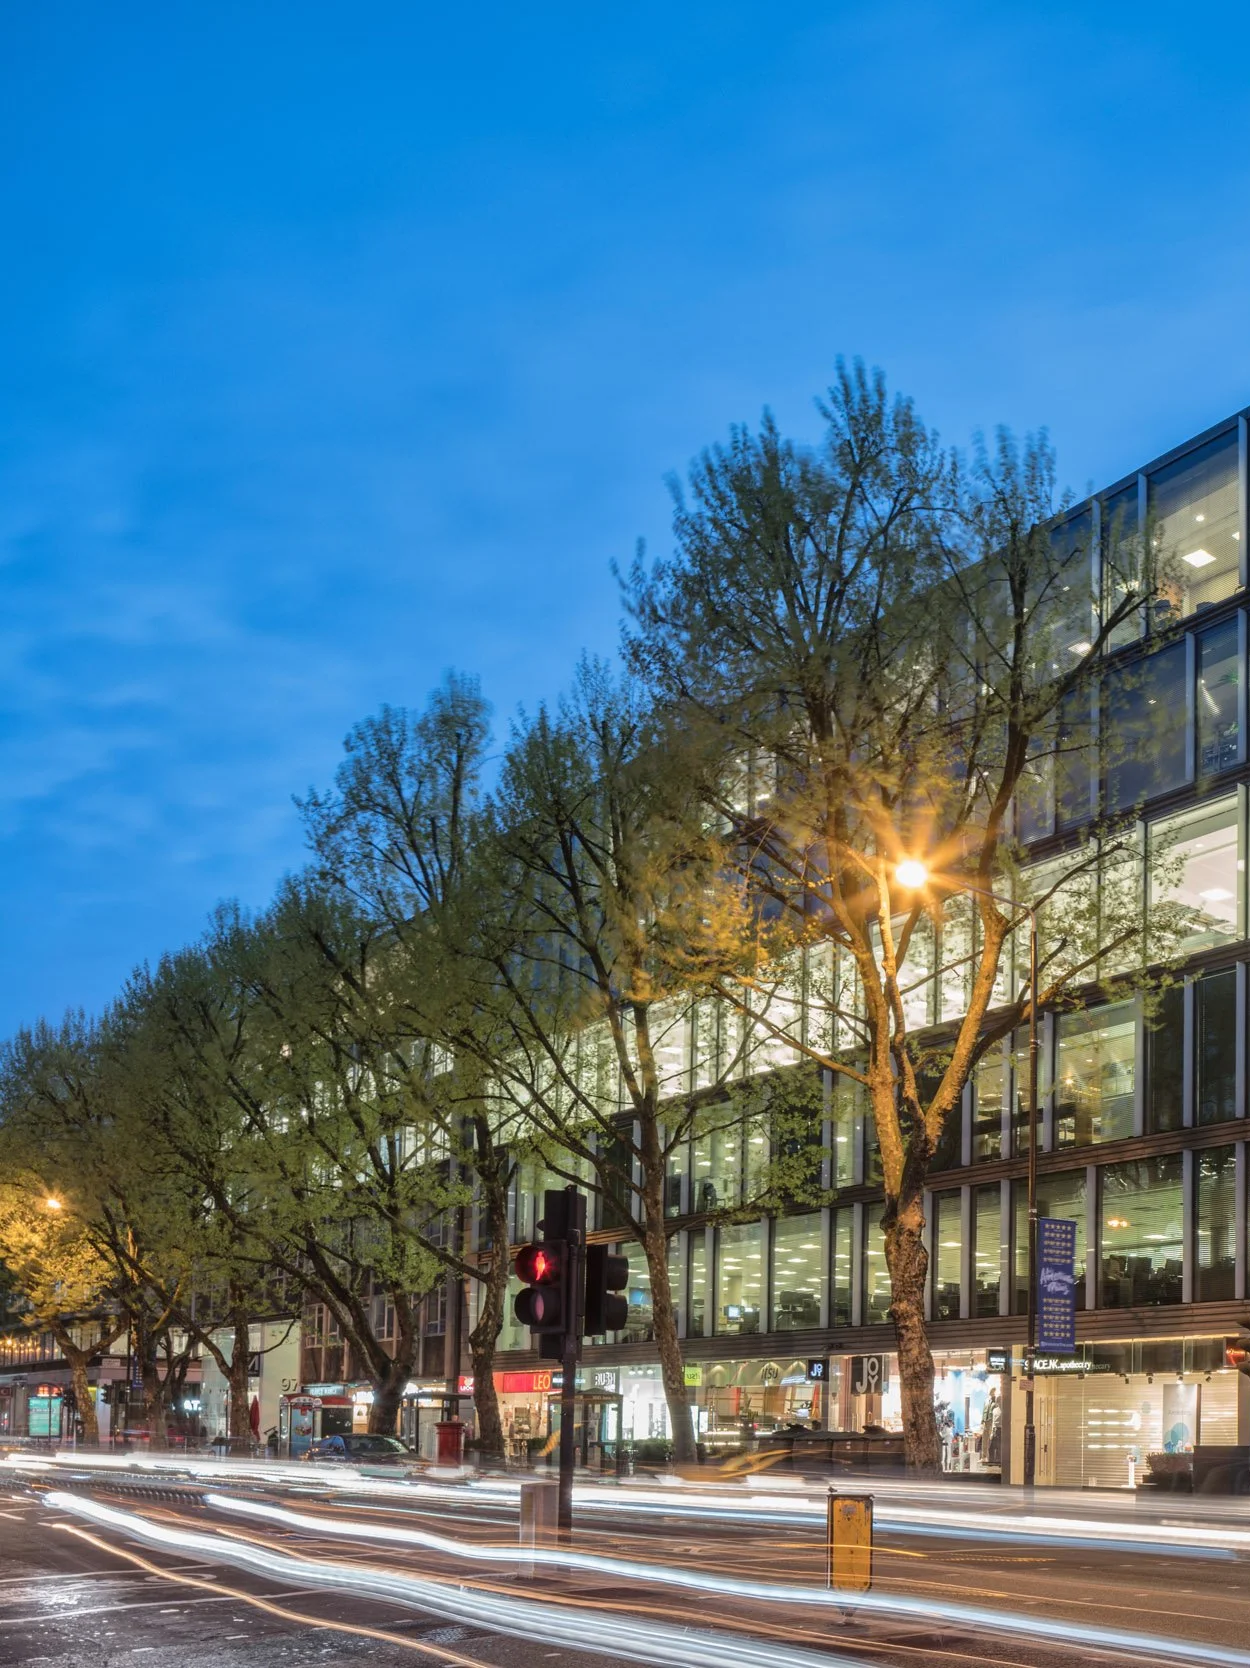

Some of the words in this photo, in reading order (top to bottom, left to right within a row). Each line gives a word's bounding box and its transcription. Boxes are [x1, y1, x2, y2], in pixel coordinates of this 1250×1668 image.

[810, 1363, 824, 1377] JOY
[855, 1357, 879, 1393] JOY
[281, 1378, 298, 1392] 97
[533, 1374, 551, 1390] LEO
